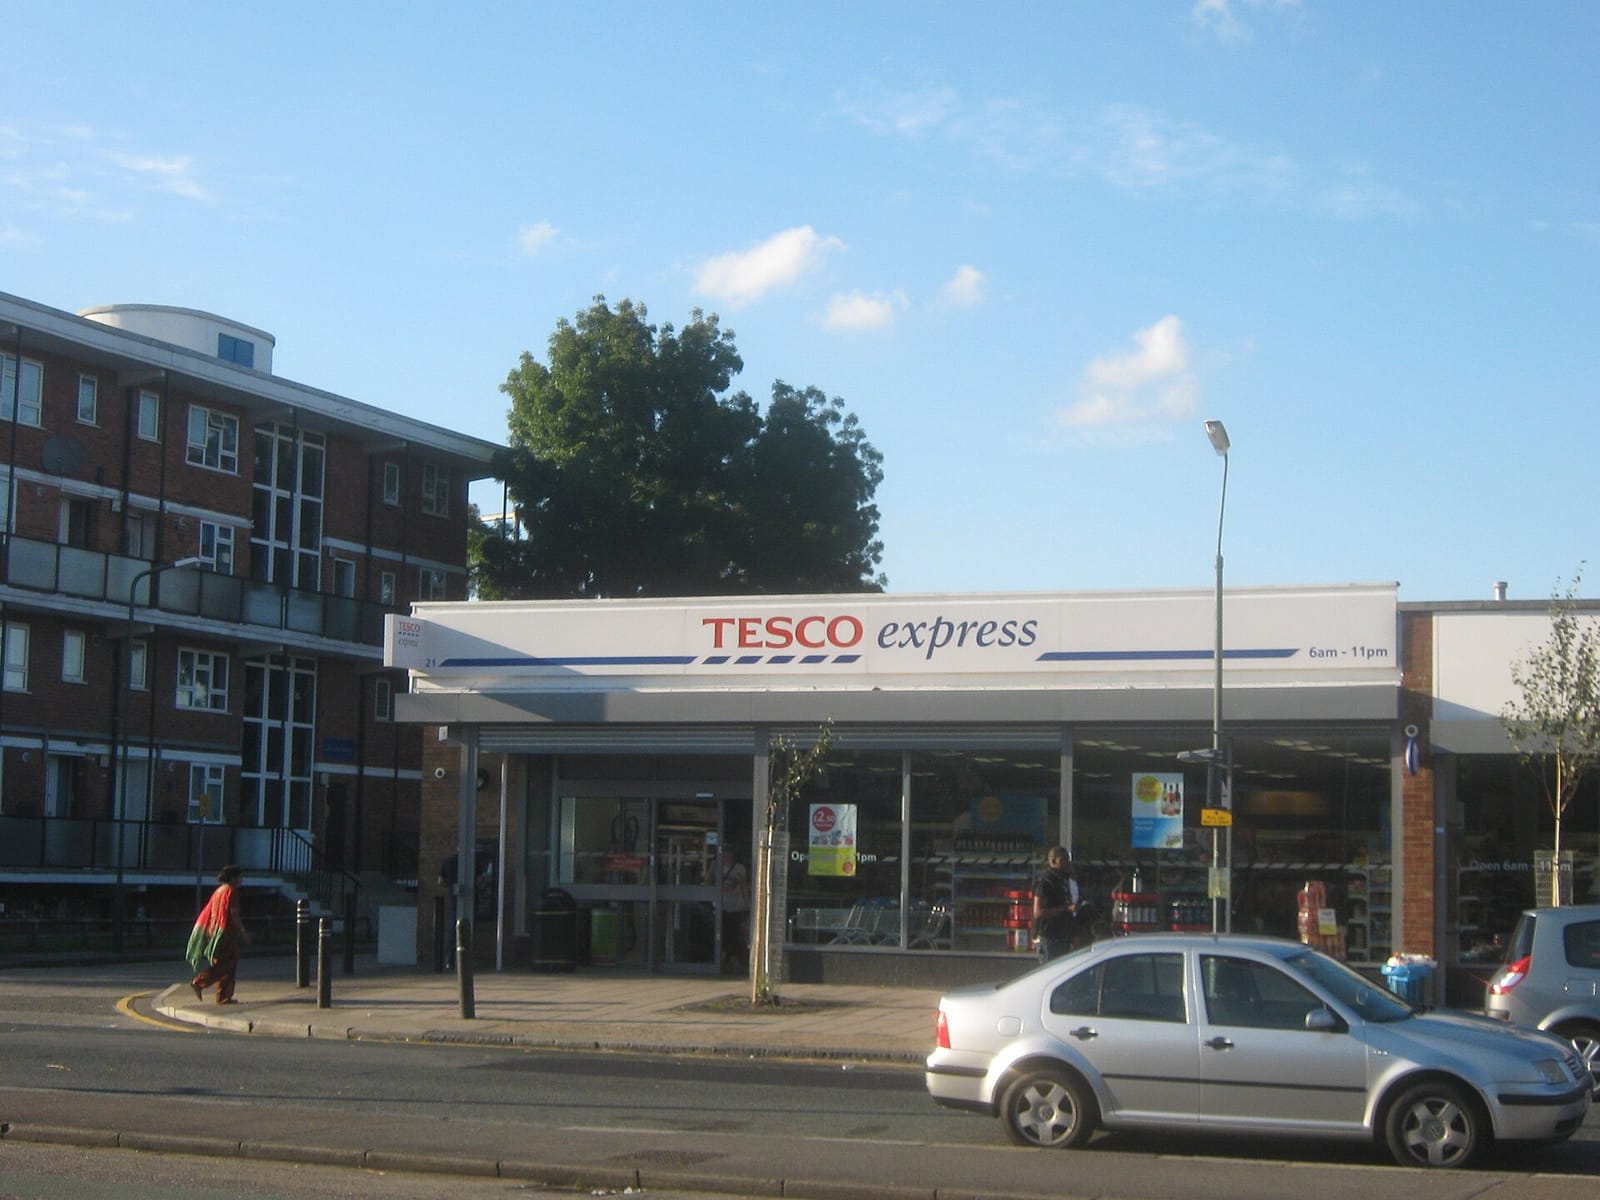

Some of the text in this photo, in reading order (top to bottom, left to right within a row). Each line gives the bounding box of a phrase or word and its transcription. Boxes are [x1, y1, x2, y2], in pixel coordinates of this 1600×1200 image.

[399, 621, 421, 632] TESCO
[702, 615, 1038, 661] TESCO express
[1309, 646, 1338, 658] 6am
[1351, 646, 1388, 660] 11pm
[425, 658, 436, 667] 21
[1540, 860, 1571, 872] 11m
